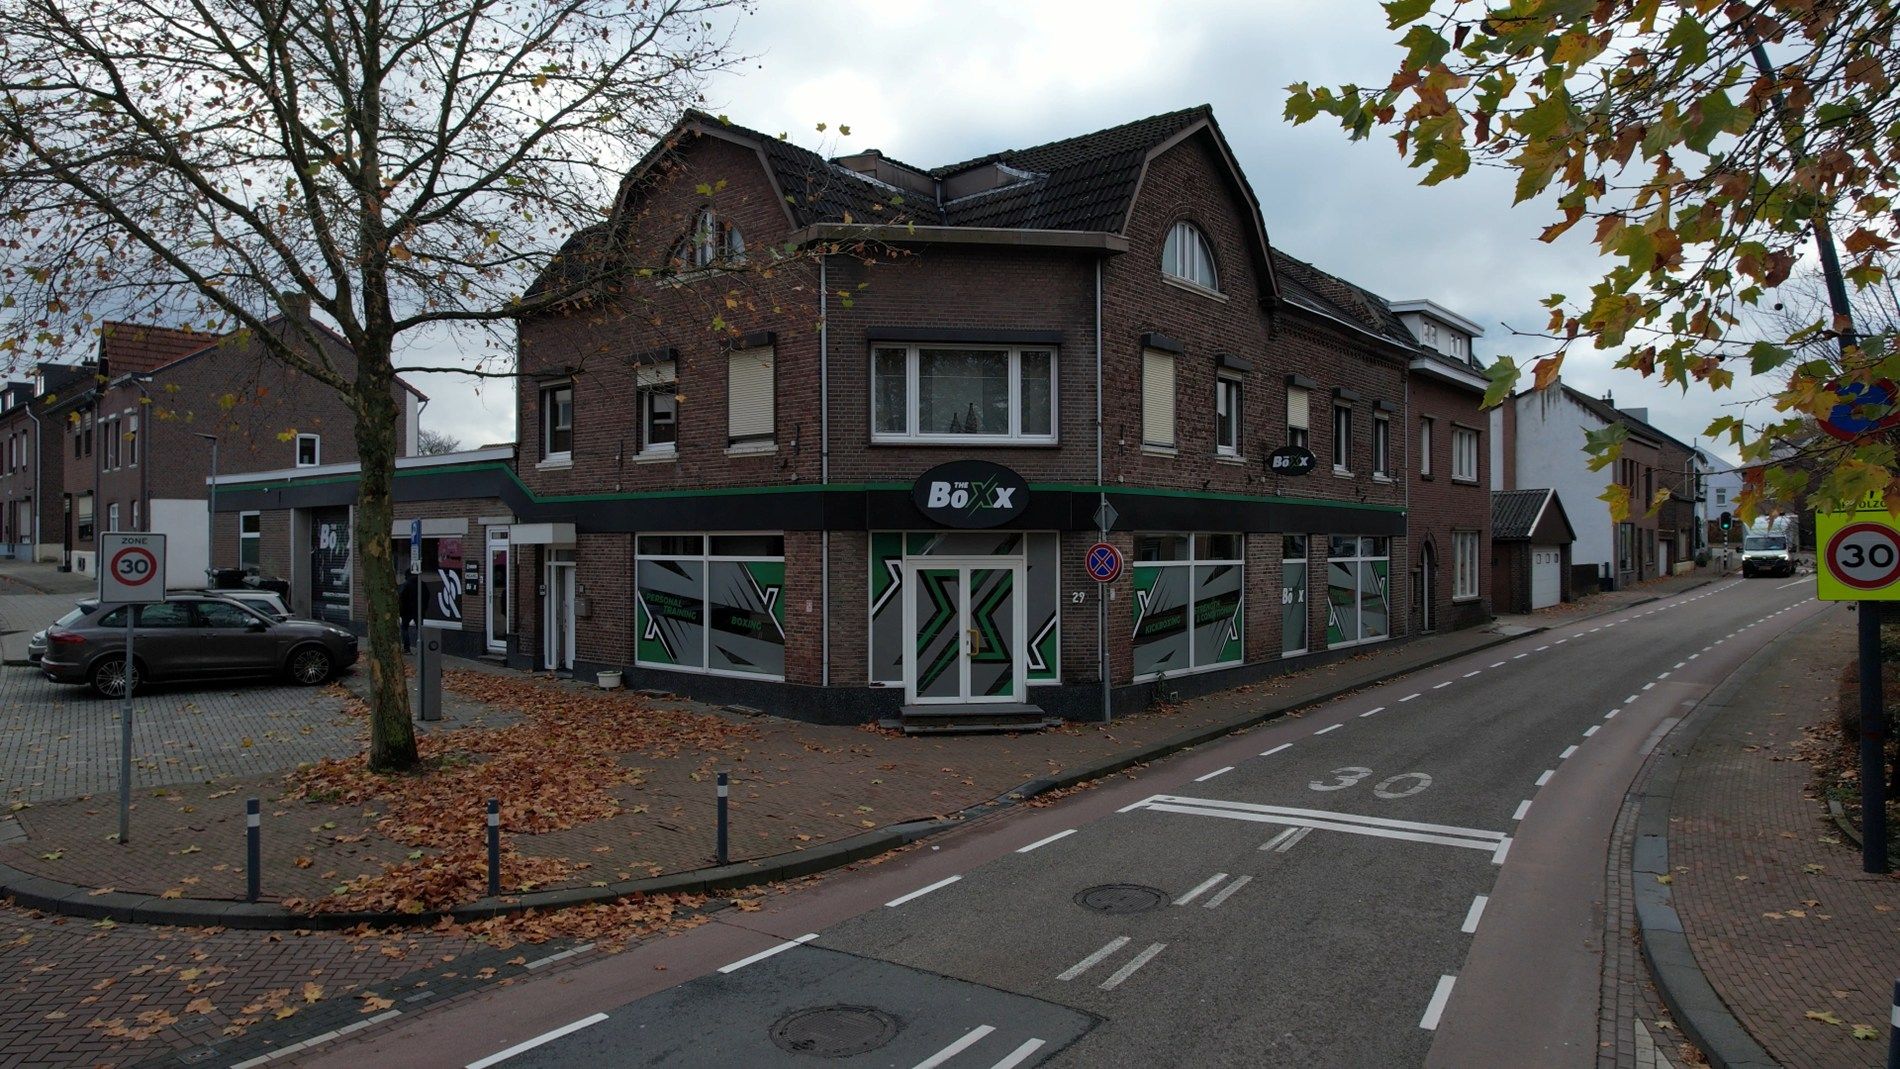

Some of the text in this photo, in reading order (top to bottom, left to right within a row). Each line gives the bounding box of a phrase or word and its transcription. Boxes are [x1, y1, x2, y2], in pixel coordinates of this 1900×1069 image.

[954, 481, 969, 489] THE
[1842, 544, 1893, 568] 30
[120, 559, 149, 574] 30
[646, 593, 682, 607] PERSONAL
[1072, 591, 1085, 604] 29
[663, 605, 697, 620] TRAINING
[731, 616, 763, 630] BOXING
[1308, 766, 1433, 799] 30
